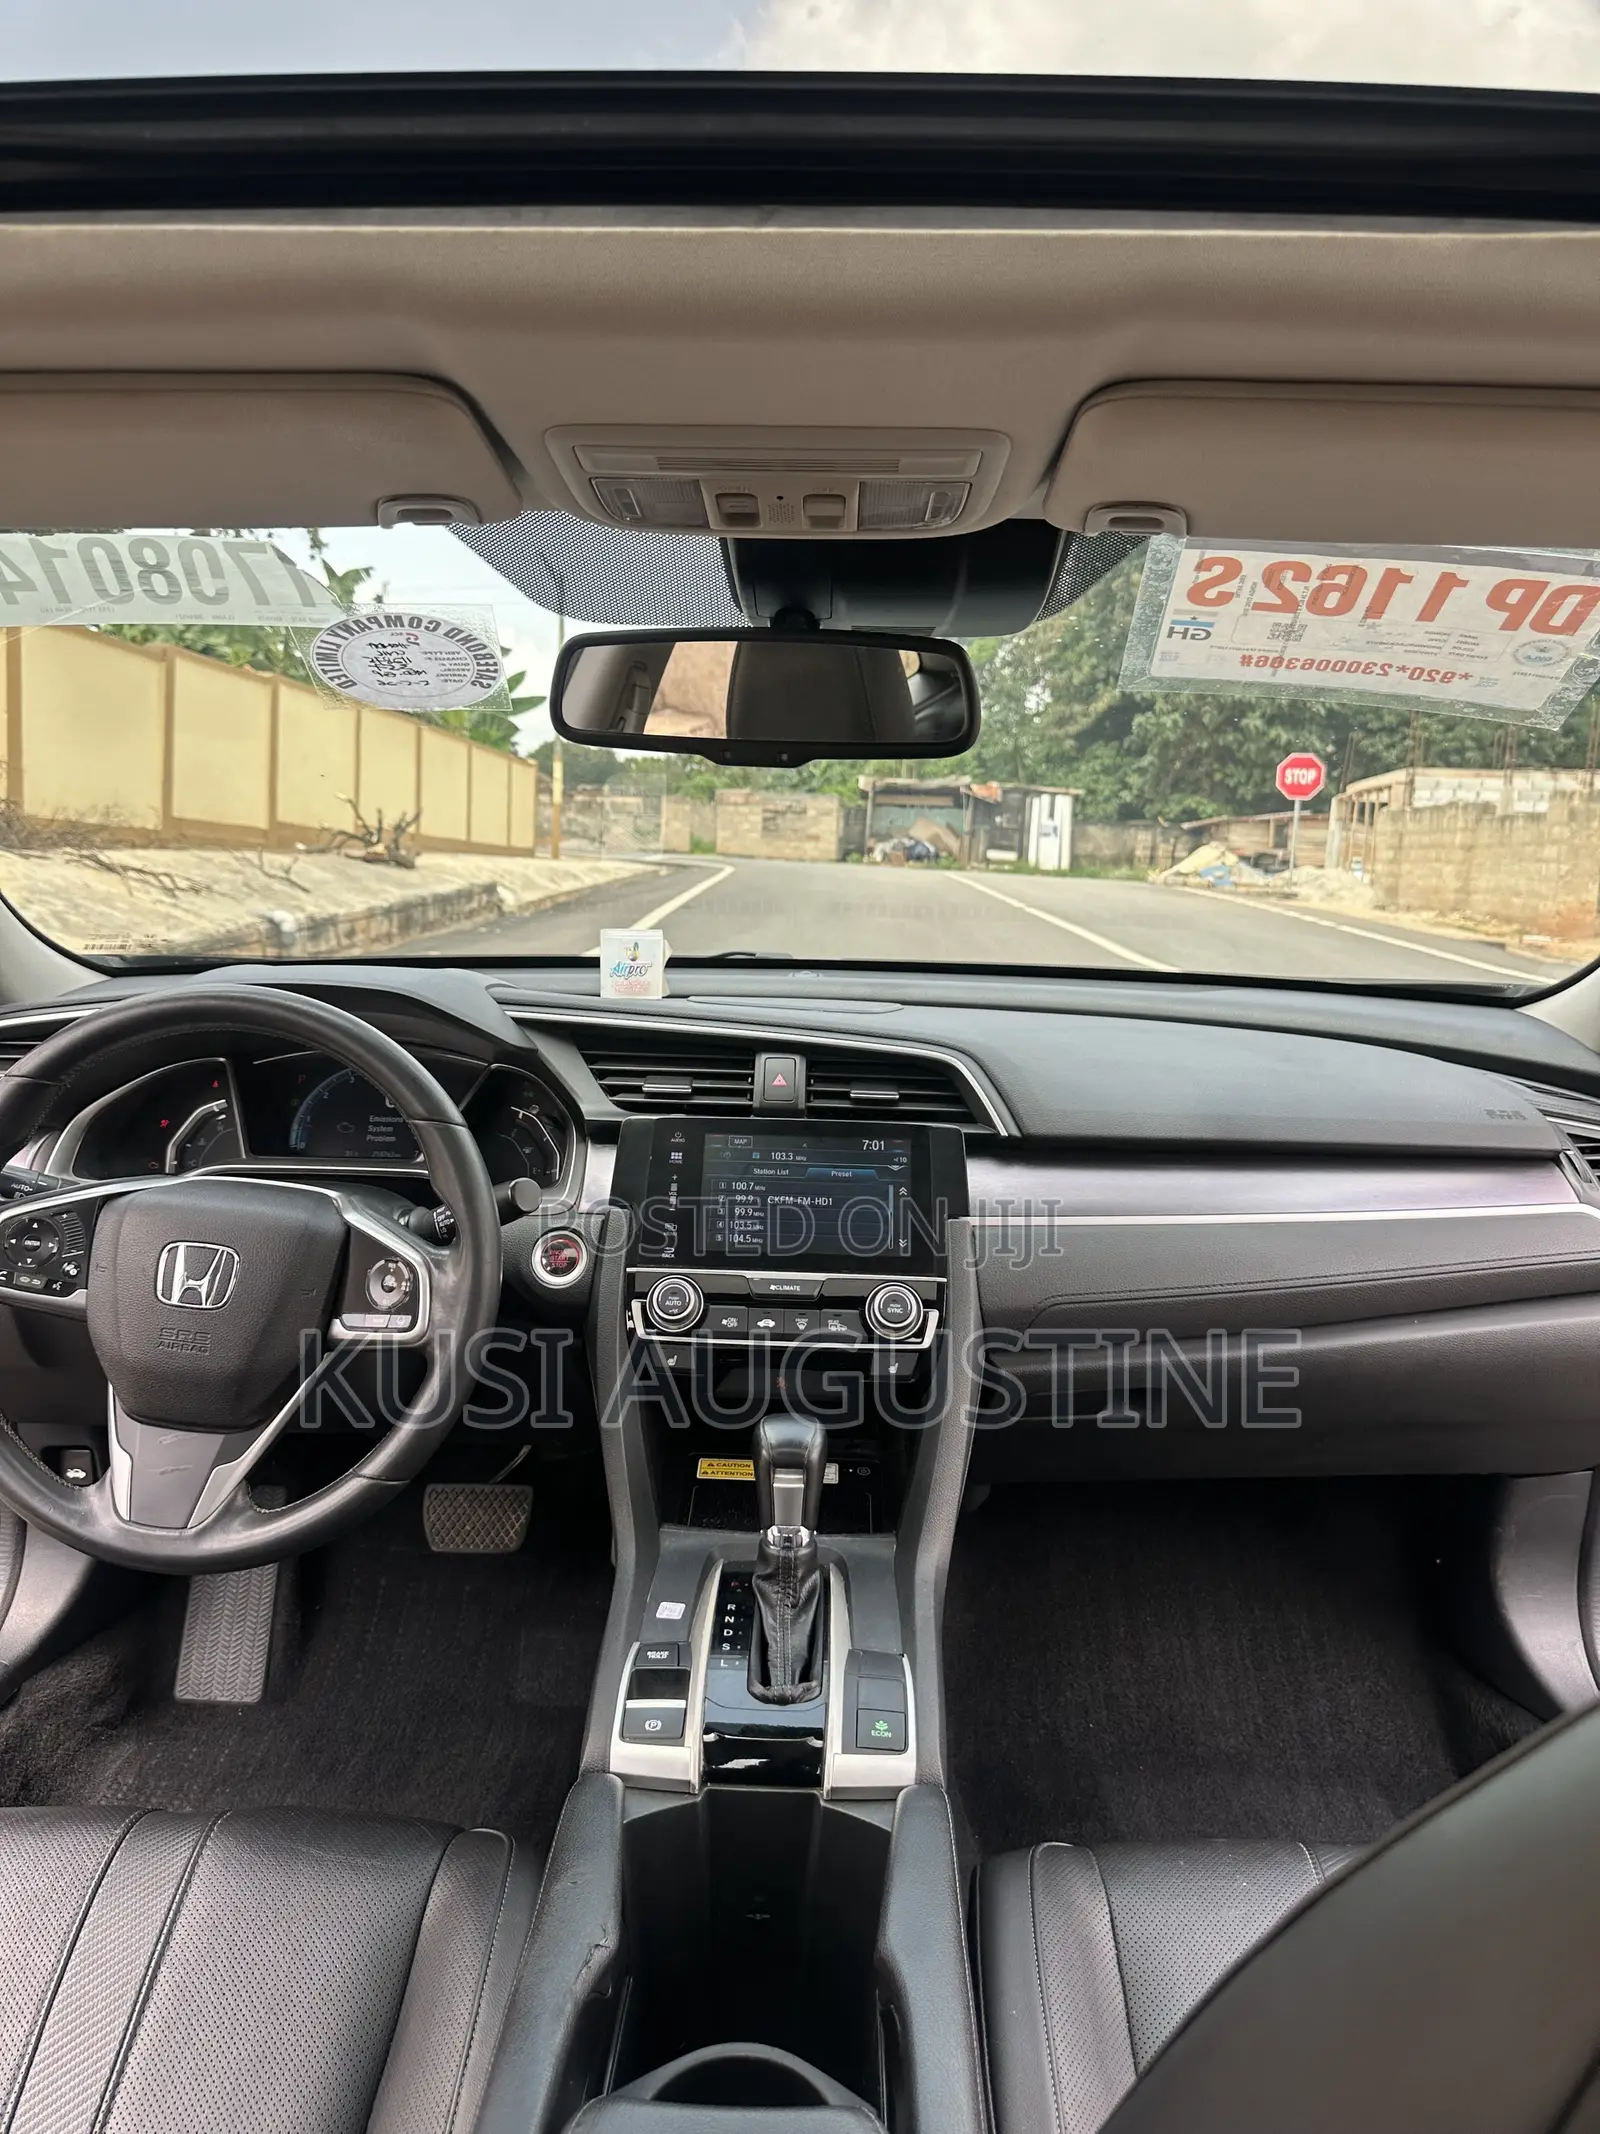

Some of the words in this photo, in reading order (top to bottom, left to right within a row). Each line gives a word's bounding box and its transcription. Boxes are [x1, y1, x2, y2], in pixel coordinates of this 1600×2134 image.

[1284, 767, 1317, 785] STOP
[369, 1115, 404, 1123] Emissions
[368, 1125, 394, 1133] System
[366, 1135, 396, 1143] Problem
[862, 1139, 885, 1151] 7:01
[771, 1152, 794, 1161] 103.3
[753, 1167, 776, 1176] Station
[777, 1168, 789, 1176] List
[831, 1170, 853, 1178] Preset
[731, 1182, 754, 1191] 100.7
[767, 1195, 833, 1206] CKFM-FM-HD1
[734, 1208, 753, 1217] 99.9
[730, 1221, 752, 1230] 103.5
[728, 1234, 752, 1243] 104.5
[160, 1328, 211, 1346] SRS
[157, 1341, 211, 1355] AIRBAG
[720, 1659, 728, 1667] L
[871, 1730, 892, 1738] ECON
